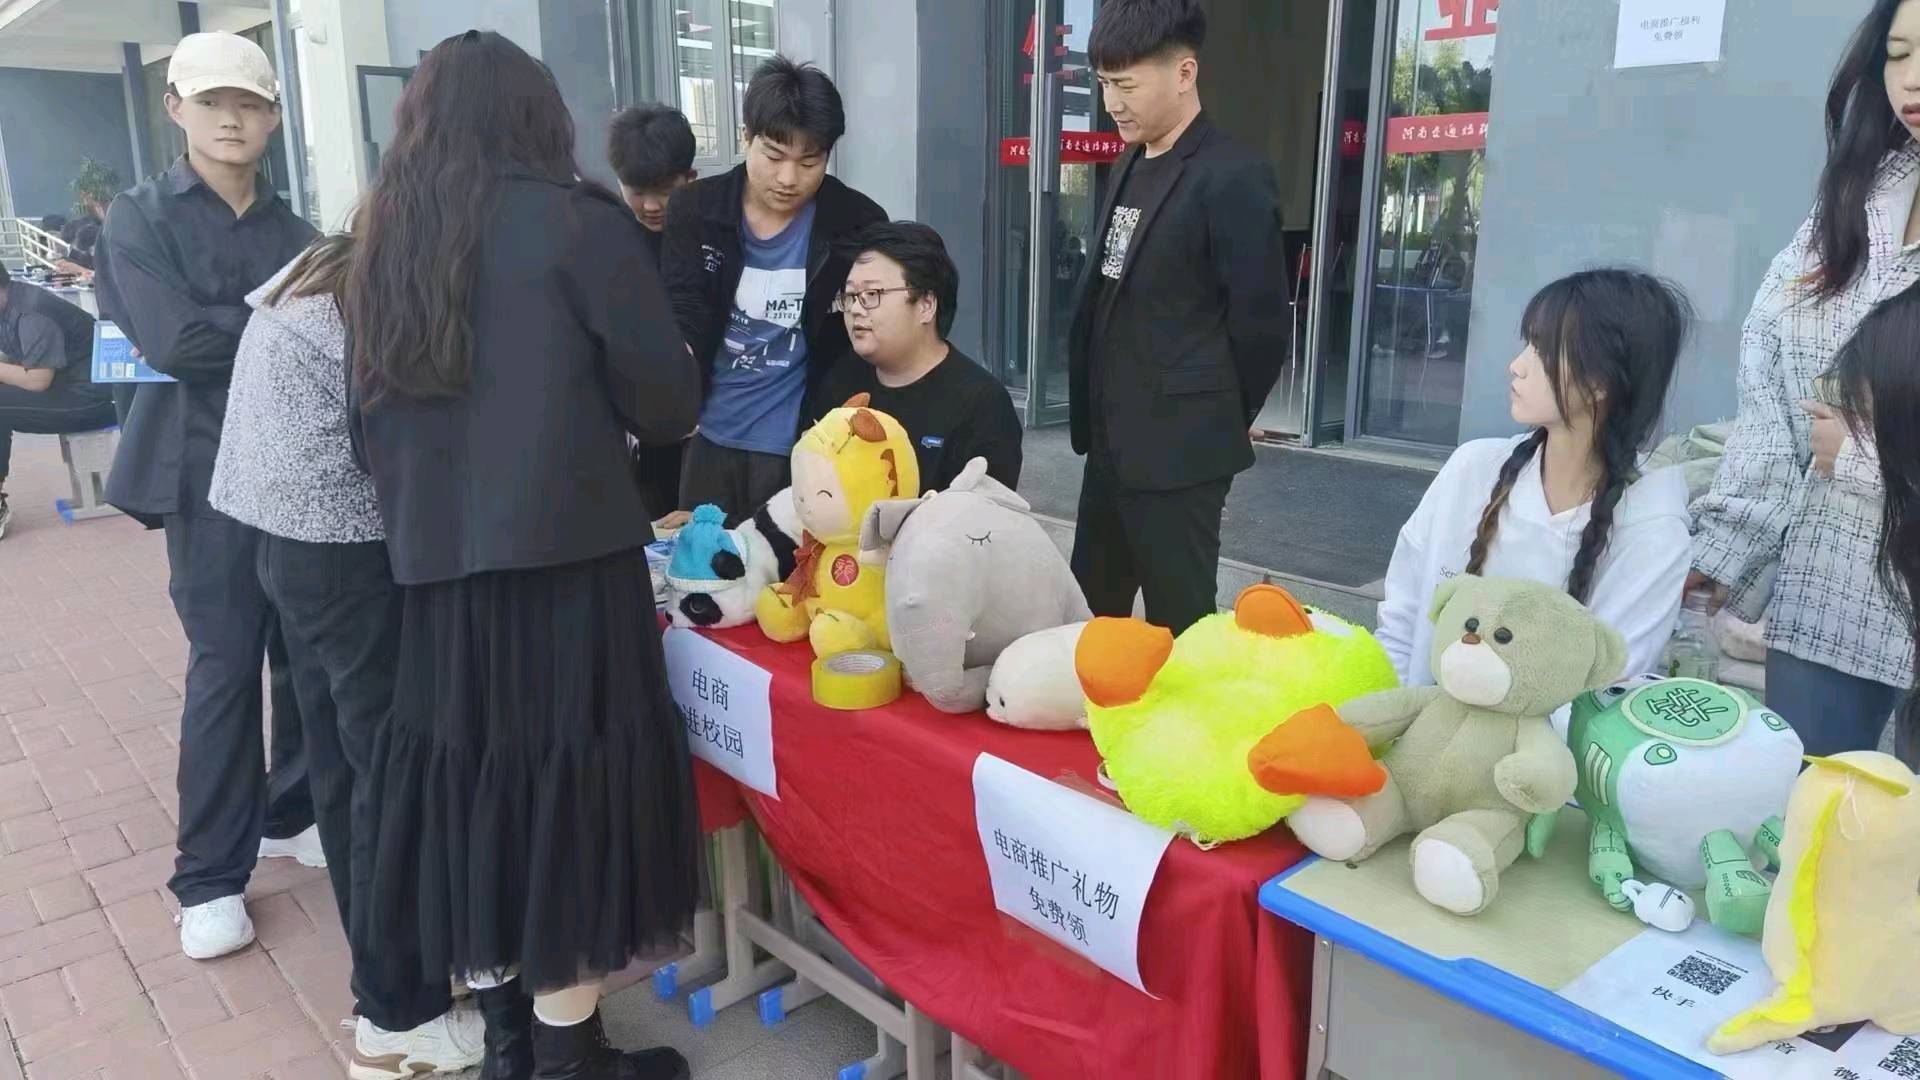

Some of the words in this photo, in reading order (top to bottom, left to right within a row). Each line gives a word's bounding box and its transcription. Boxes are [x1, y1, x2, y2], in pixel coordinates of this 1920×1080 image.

[692, 667, 729, 711] 电商
[681, 703, 744, 759] 进校园
[994, 828, 1119, 920] 电商推广礼物
[1029, 886, 1090, 947] 免费领
[1651, 985, 1696, 1008] 快手
